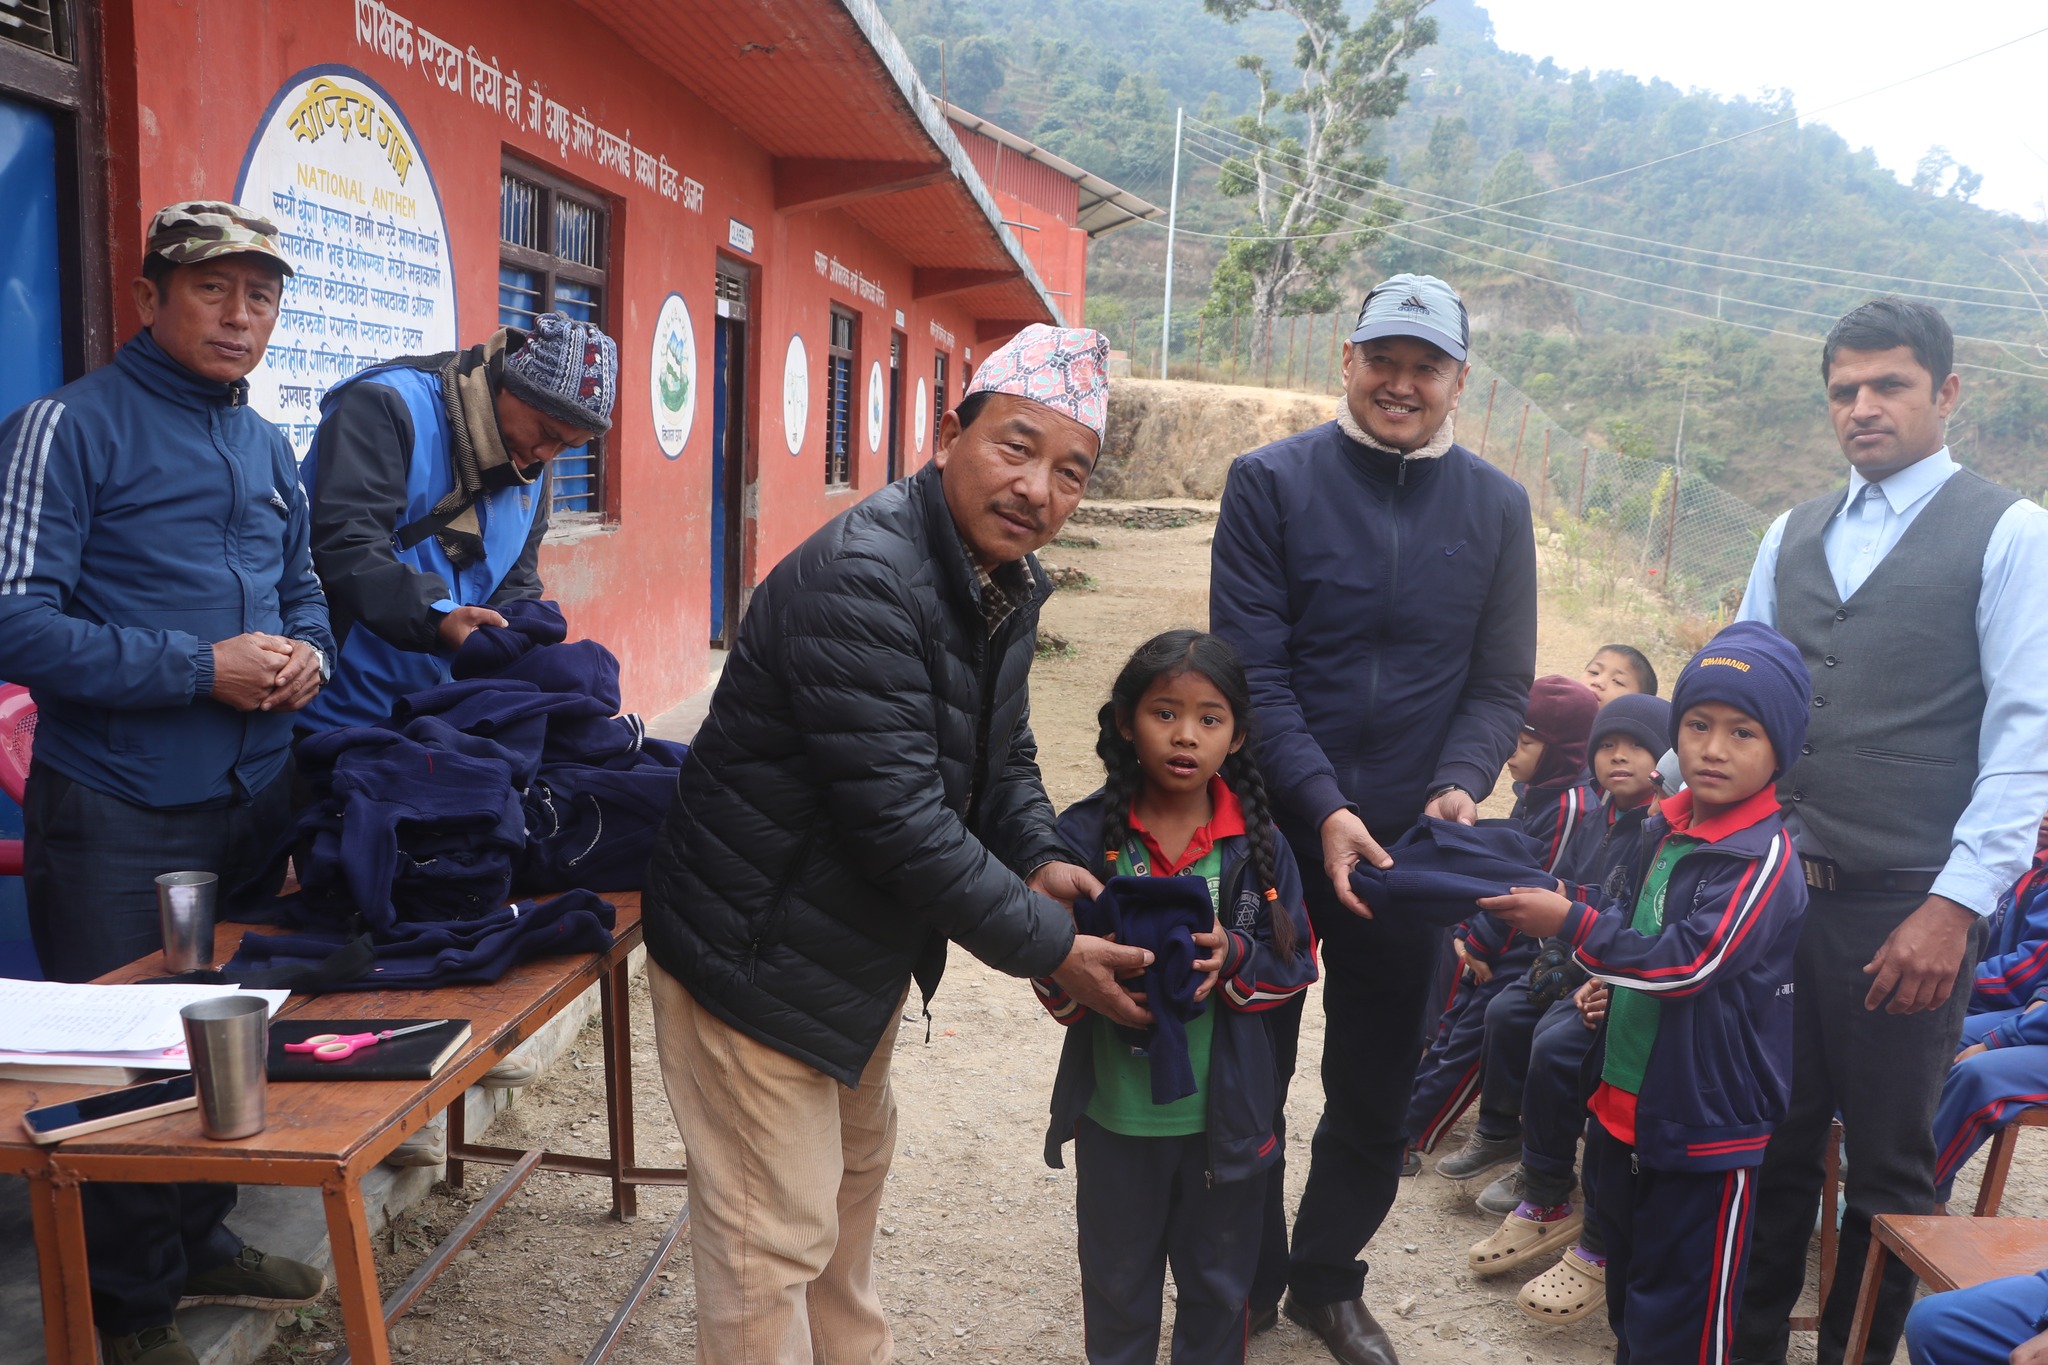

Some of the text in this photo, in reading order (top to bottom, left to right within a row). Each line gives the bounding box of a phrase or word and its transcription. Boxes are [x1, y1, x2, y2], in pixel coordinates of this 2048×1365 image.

[466, 45, 502, 115] दियो
[377, 108, 413, 188] गान
[297, 162, 417, 219] NATIONAL ANTHEM
[1397, 305, 1430, 316] adidas
[1700, 657, 1751, 673] COMMANDO
